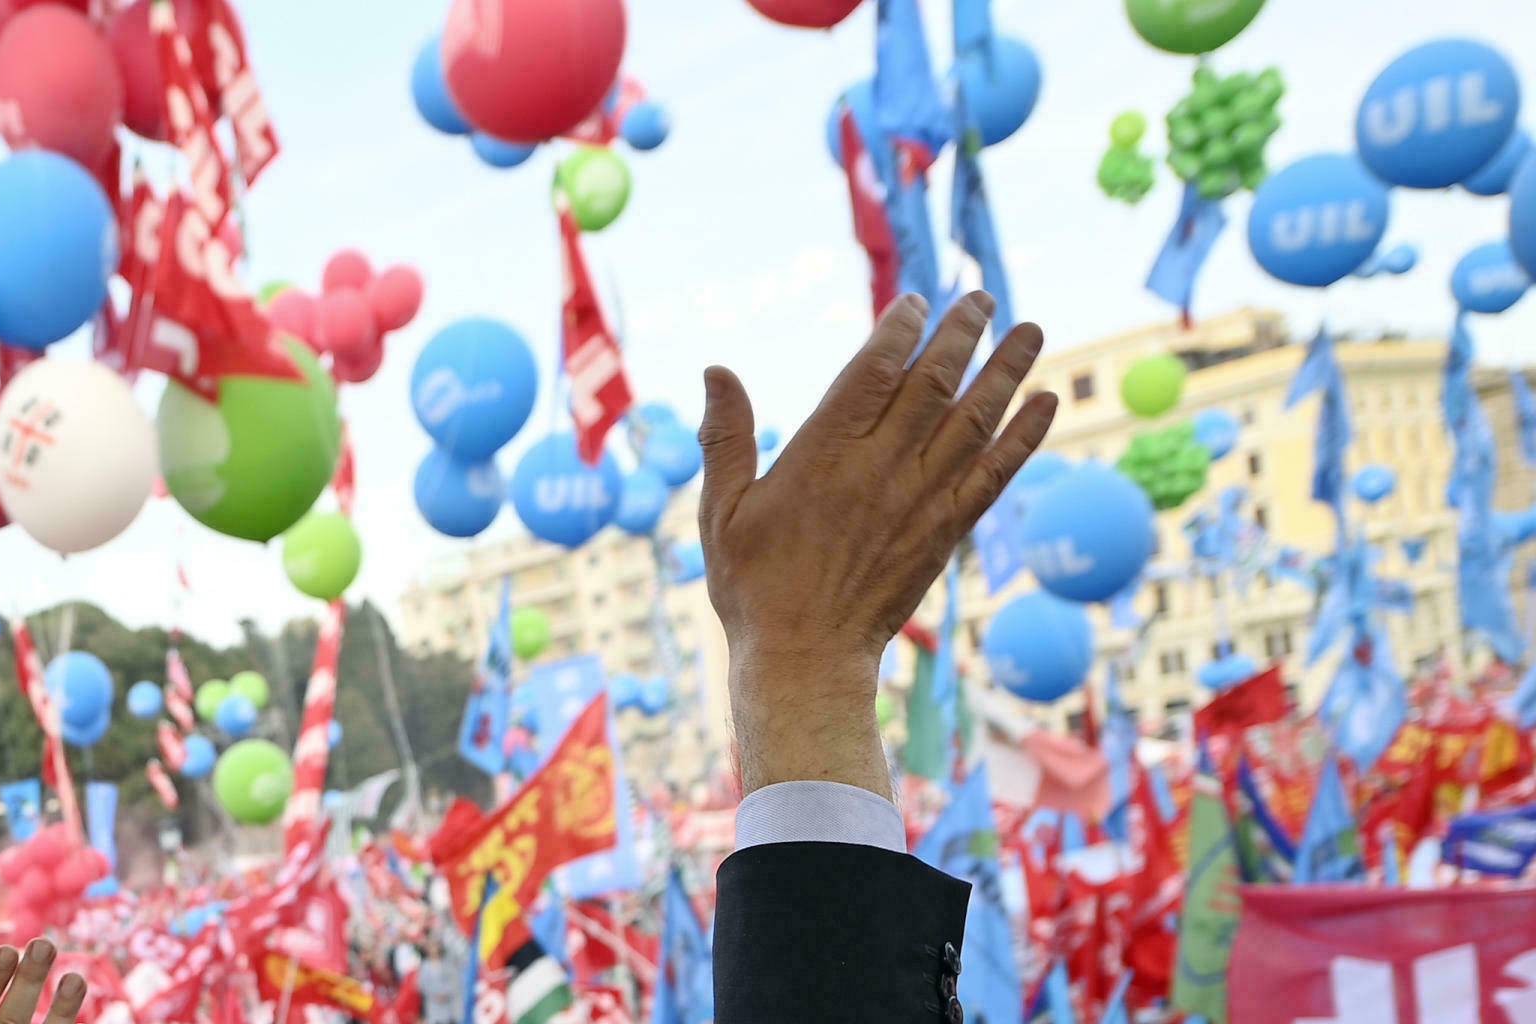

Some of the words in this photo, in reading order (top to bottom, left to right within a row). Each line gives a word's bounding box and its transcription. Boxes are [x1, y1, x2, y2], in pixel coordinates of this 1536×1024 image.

[1365, 68, 1503, 147] UIL
[1268, 197, 1376, 253] UIL
[535, 472, 613, 514] UIL
